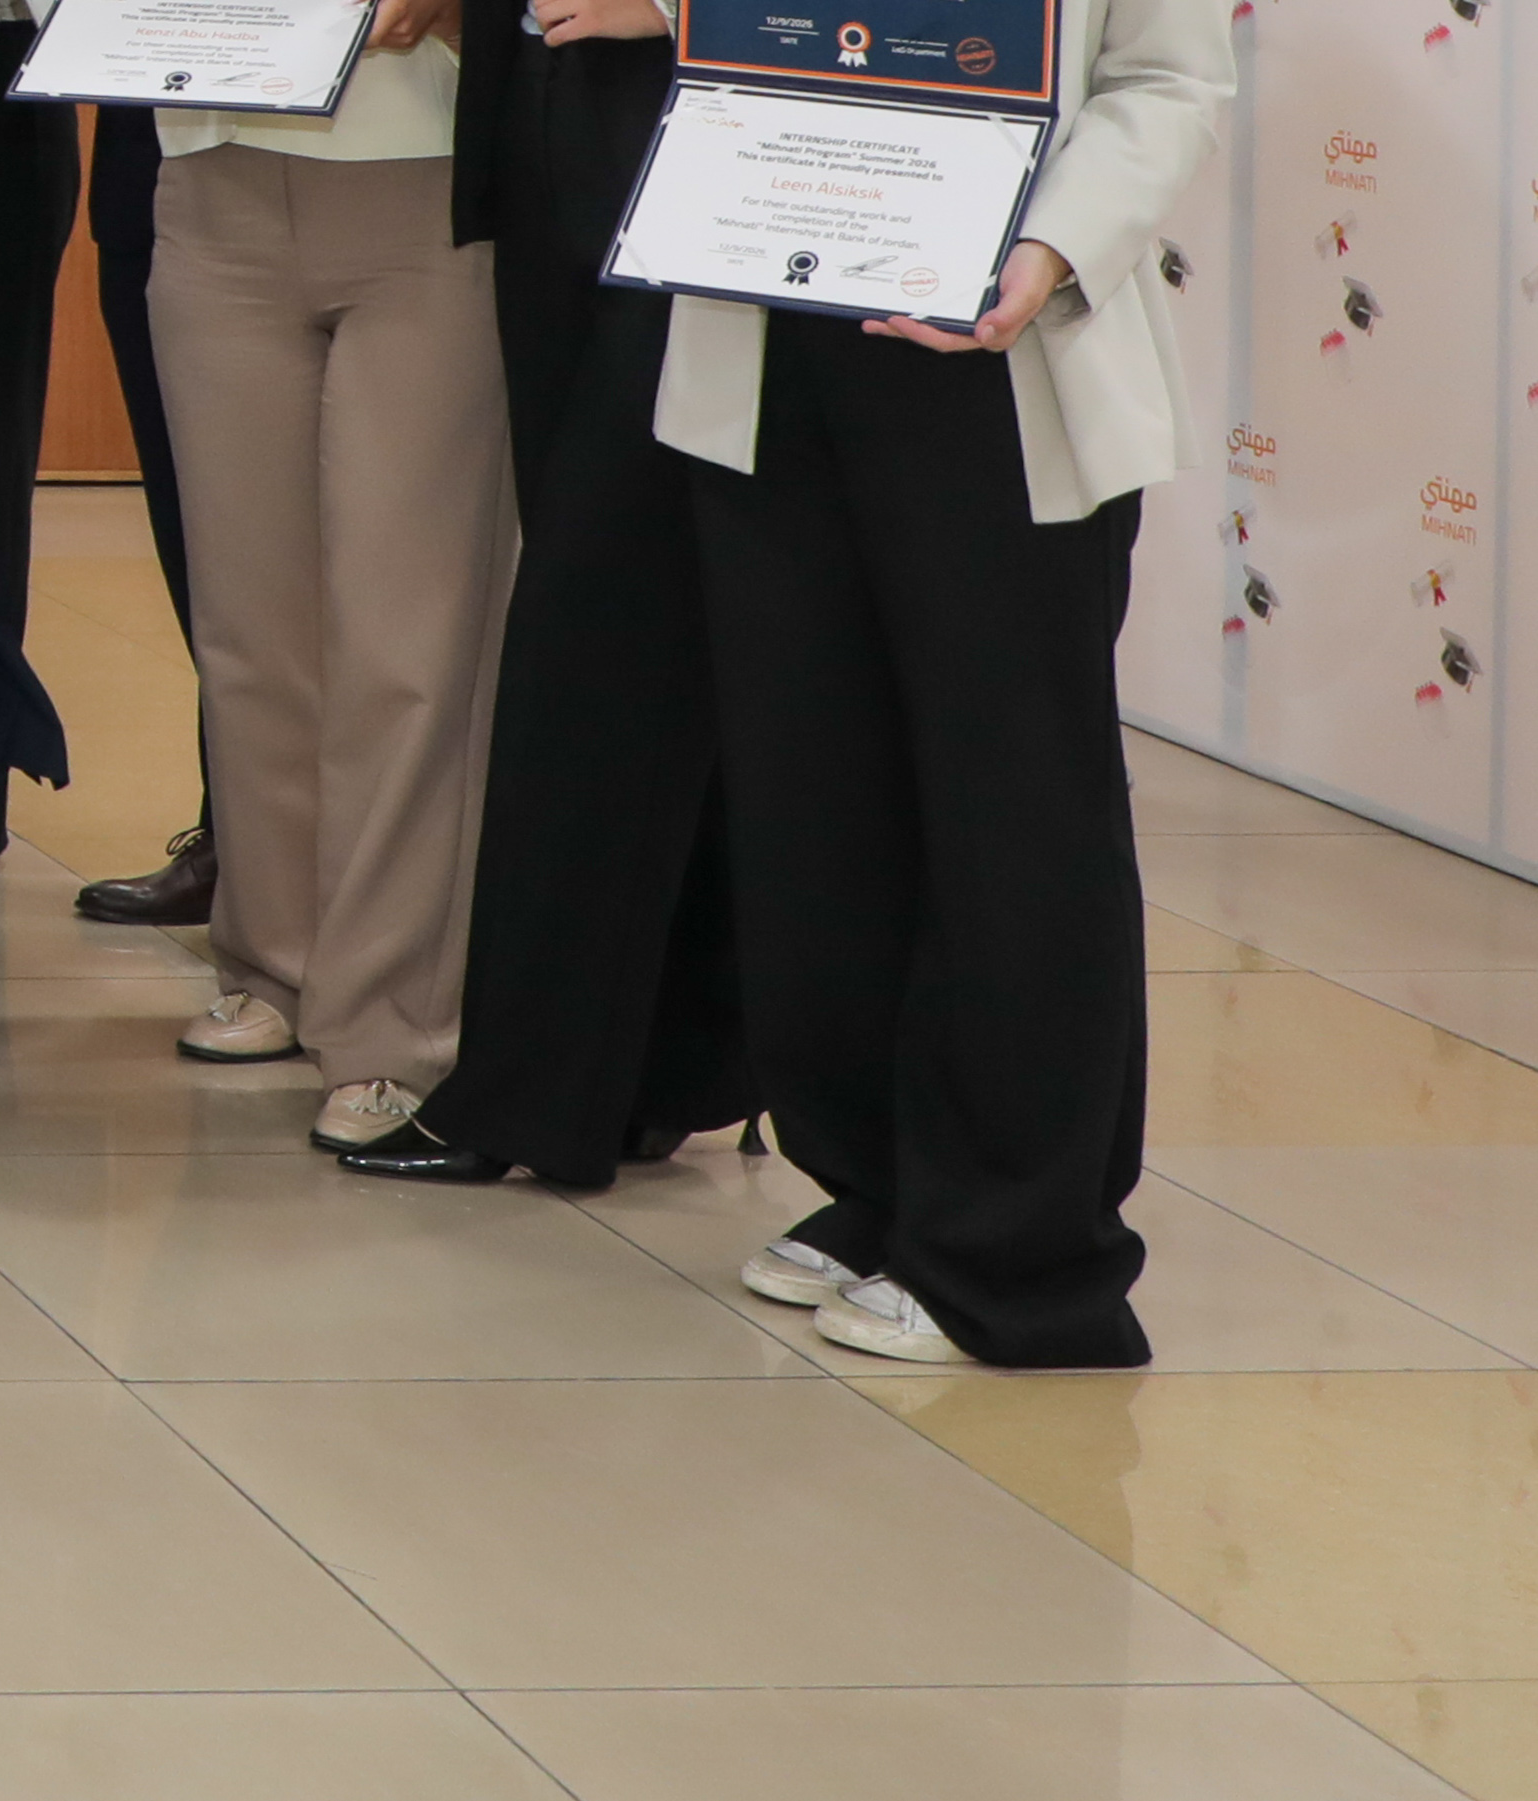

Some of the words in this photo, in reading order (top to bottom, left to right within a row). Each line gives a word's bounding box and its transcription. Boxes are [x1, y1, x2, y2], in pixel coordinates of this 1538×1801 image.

[779, 133, 848, 146] INTERNSHIP
[849, 140, 920, 155] CERTIFICATE
[1324, 131, 1377, 164] مهنتي
[737, 151, 758, 160] This
[760, 155, 815, 167] certificate
[817, 160, 826, 168] is
[828, 163, 871, 175] proudly
[872, 168, 930, 180] presented
[932, 173, 944, 181] to
[859, 153, 905, 165] Summer
[908, 158, 936, 169] 2026
[771, 176, 813, 192] Leen
[816, 182, 883, 200] Alsiksik
[1325, 170, 1377, 193] MIHNATI
[741, 196, 760, 205] For
[762, 199, 788, 209] their
[790, 204, 857, 220] outstanding
[859, 213, 887, 221] work
[889, 216, 912, 224] and
[771, 213, 839, 228] completion
[836, 220, 848, 228] of
[849, 222, 869, 231] the
[765, 223, 821, 239] Internship
[837, 232, 866, 243] Bank
[868, 236, 881, 244] of
[1227, 423, 1276, 457] مهنتي
[1227, 460, 1276, 486] MIHNATI
[1421, 476, 1477, 518] مهنتي
[1421, 514, 1477, 546] MIHNATI
